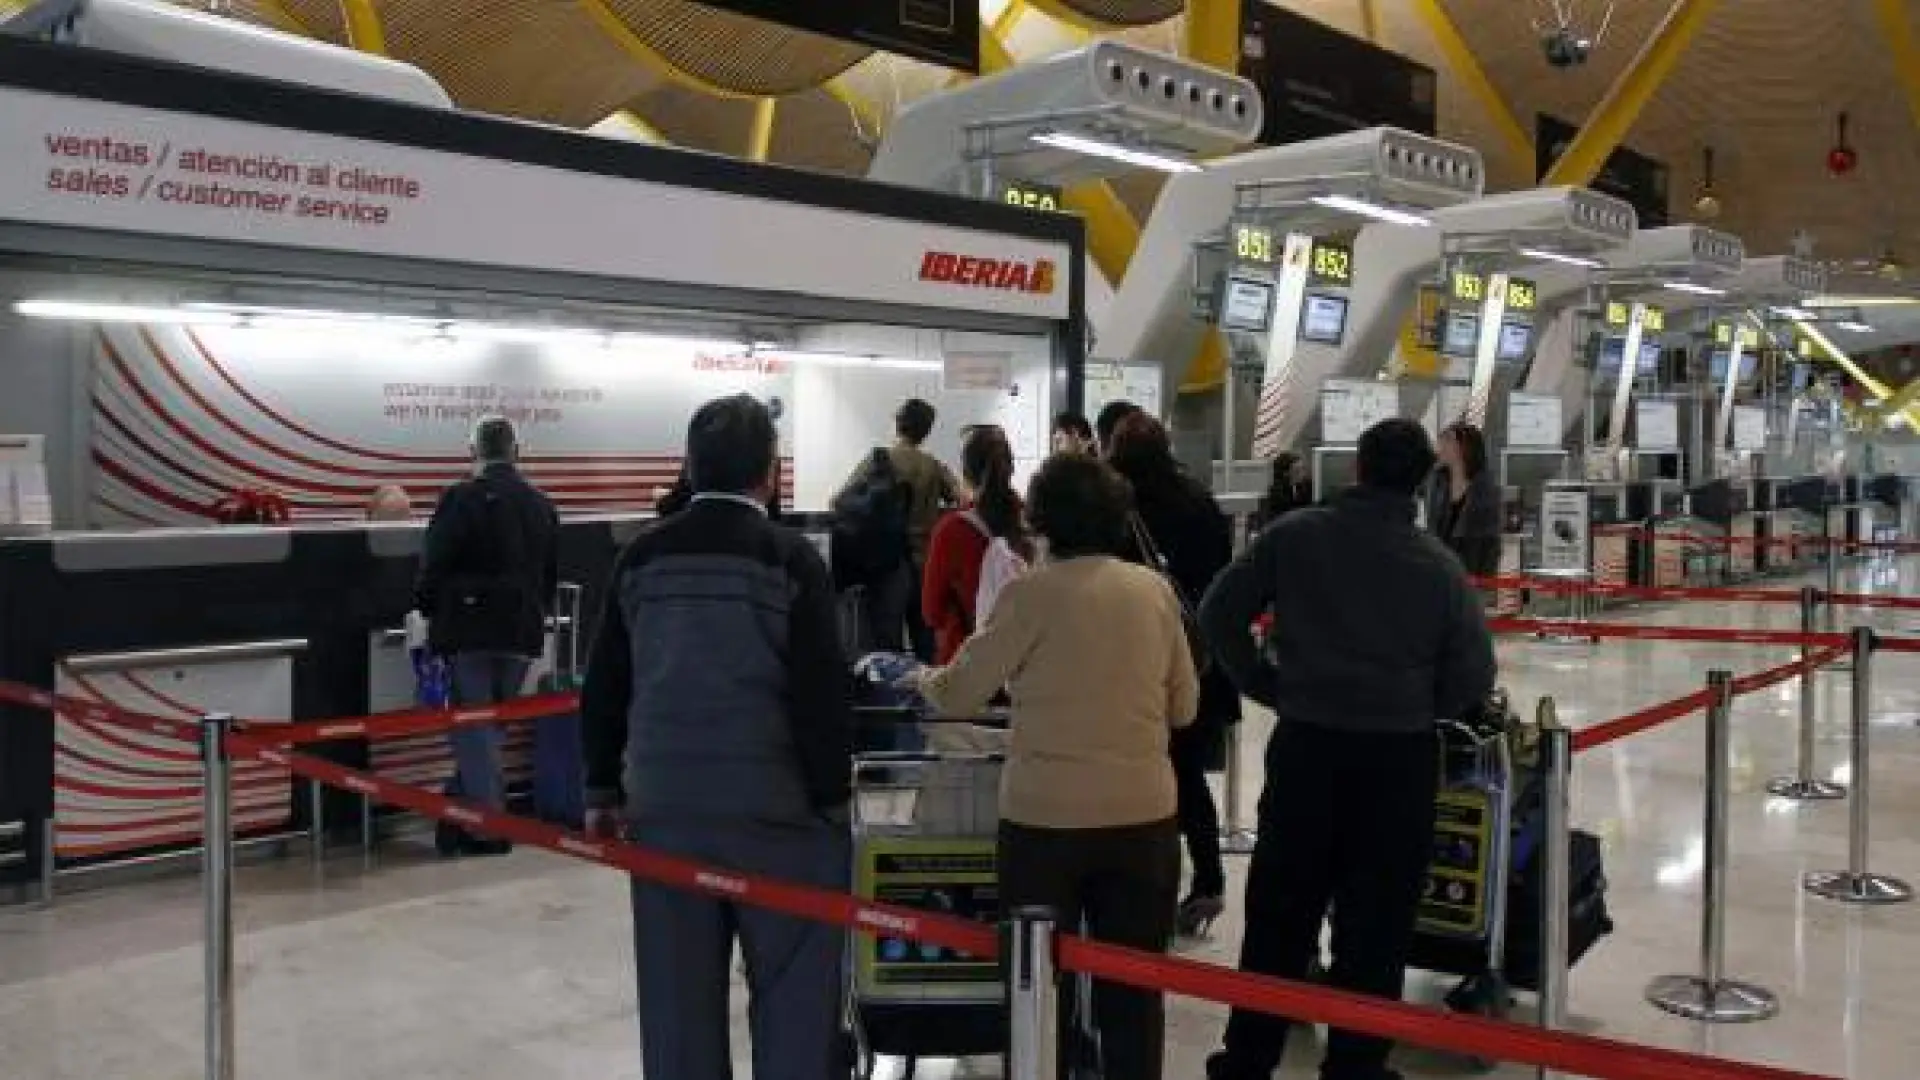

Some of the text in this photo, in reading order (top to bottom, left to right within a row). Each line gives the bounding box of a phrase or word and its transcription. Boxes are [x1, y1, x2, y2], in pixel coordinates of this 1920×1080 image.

[44, 133, 420, 198] ventas / atención al cliente
[47, 167, 389, 224] sales / customer service
[1237, 228, 1272, 263] 851
[1313, 246, 1349, 279] 852
[920, 251, 1029, 291] IBERIA
